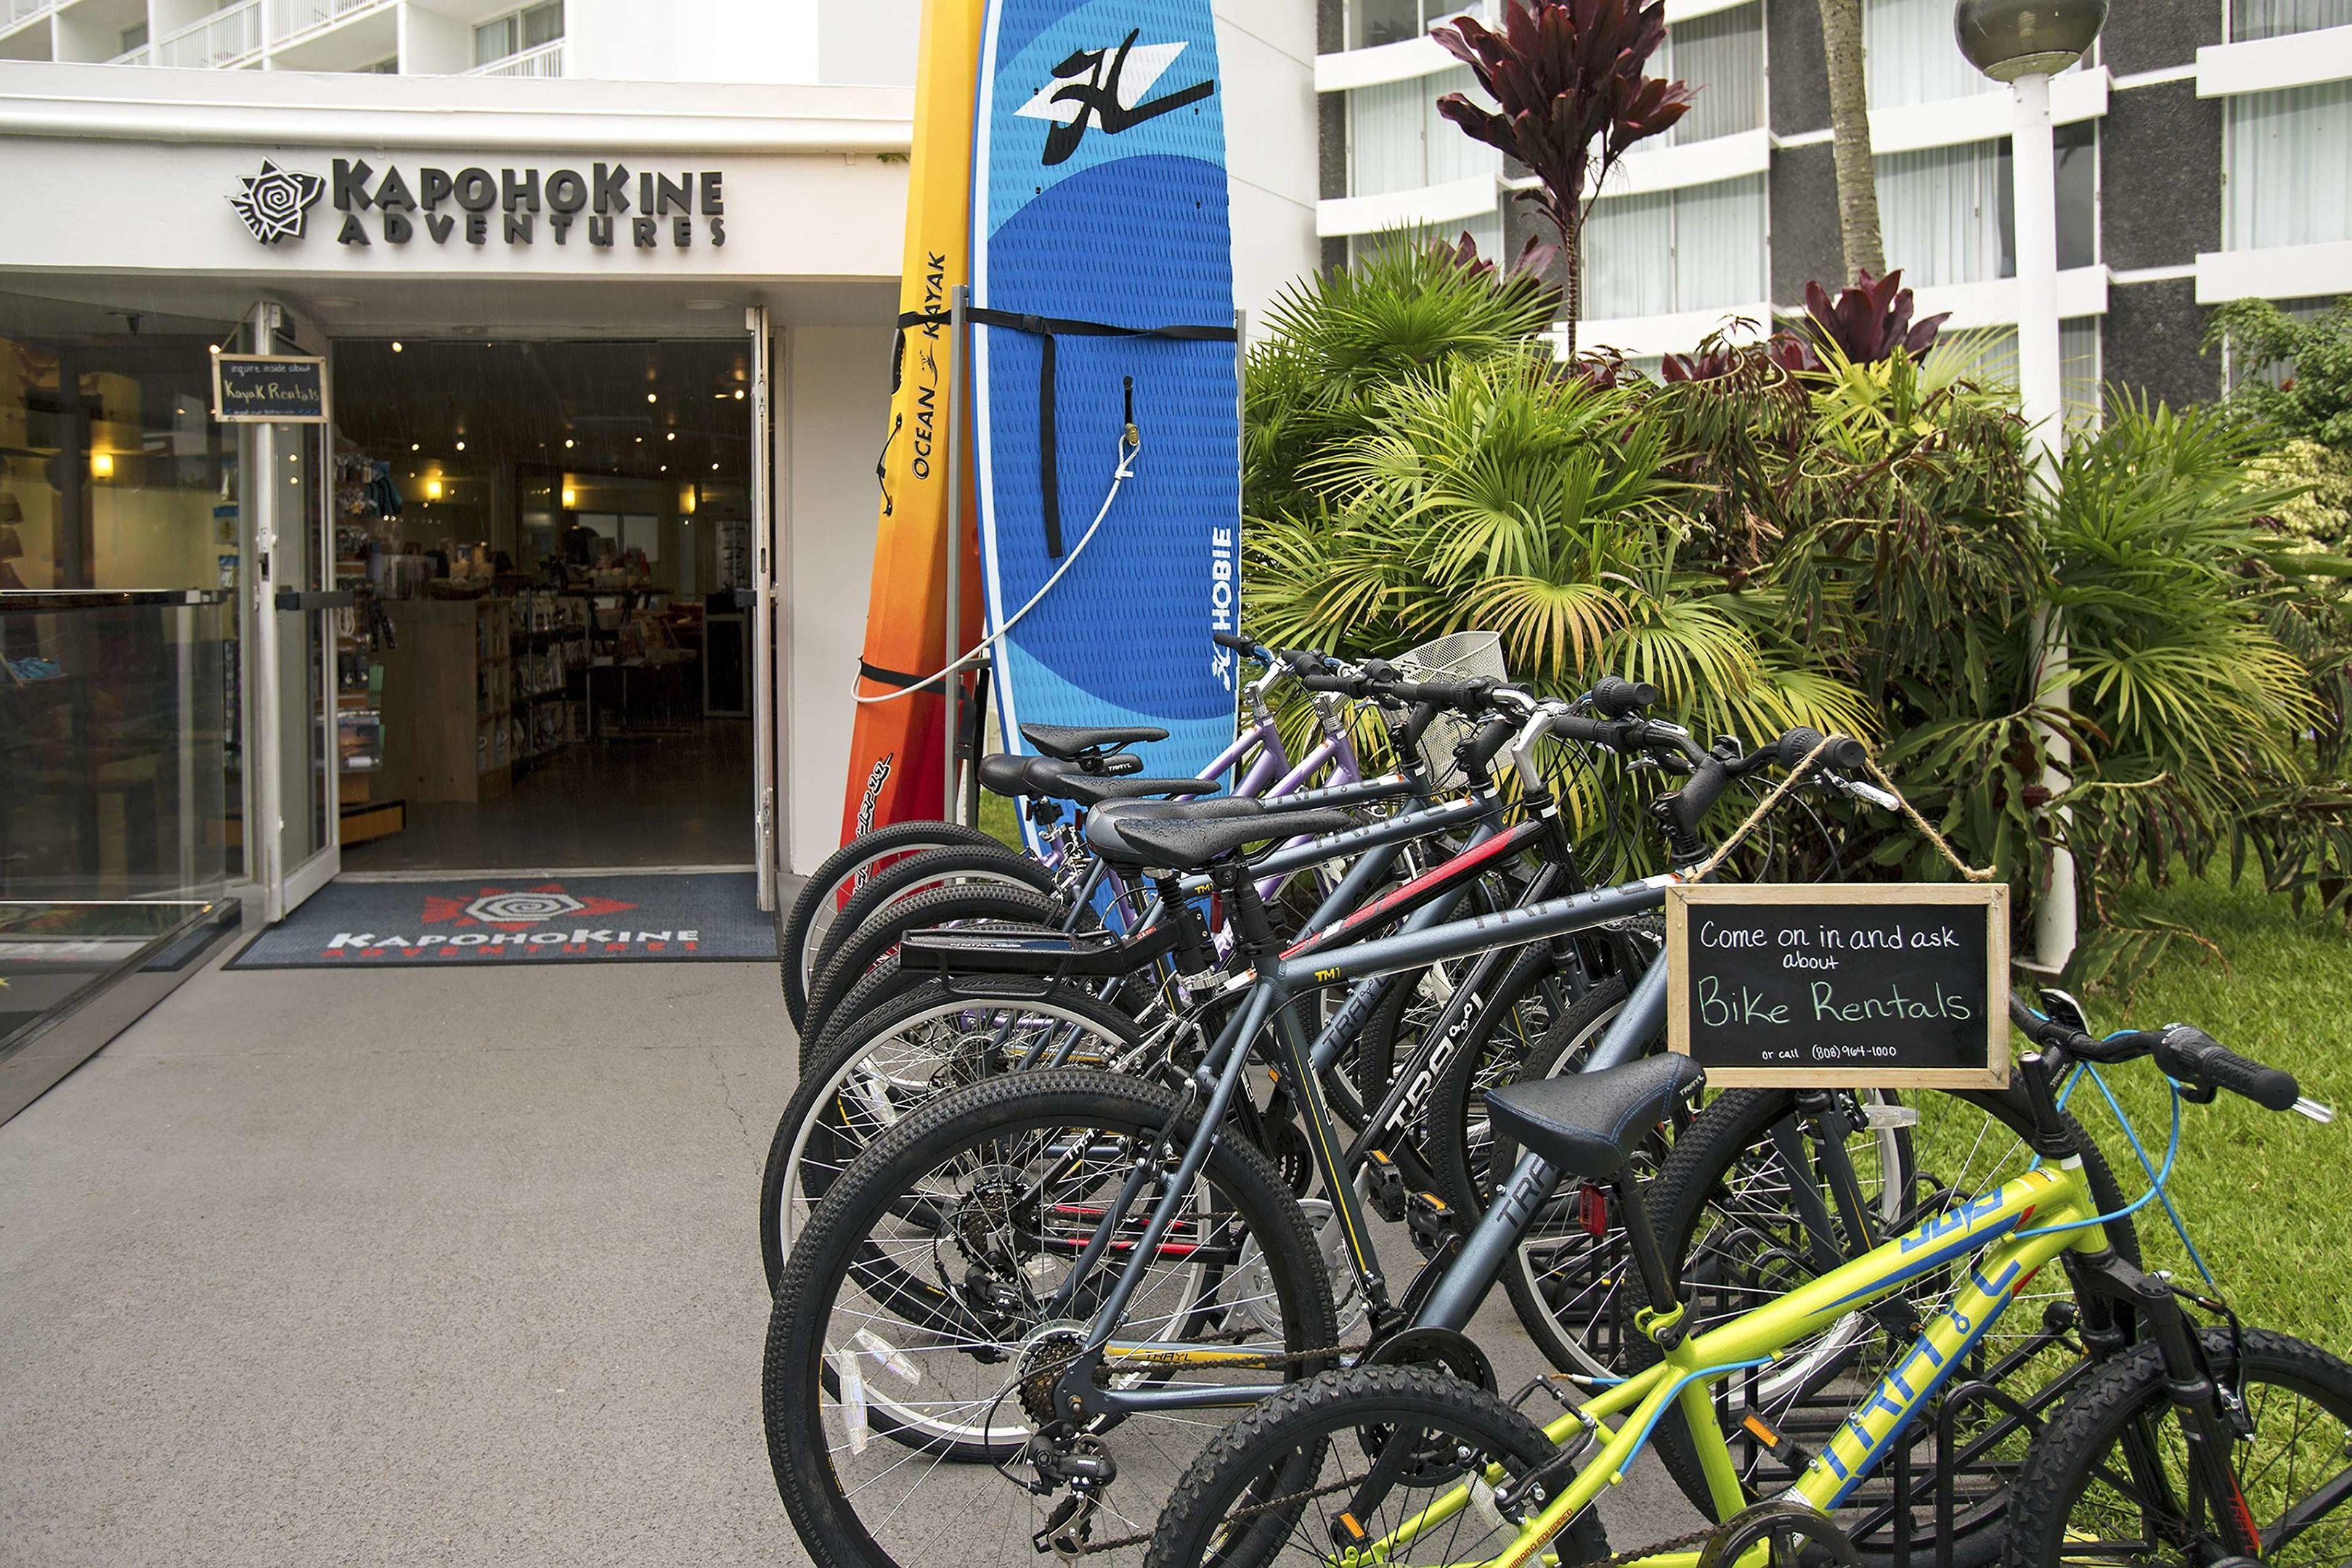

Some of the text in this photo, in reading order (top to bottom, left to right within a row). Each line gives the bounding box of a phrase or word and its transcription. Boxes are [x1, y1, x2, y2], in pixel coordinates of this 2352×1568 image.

[332, 158, 725, 216] KAPOHOKINE
[338, 213, 725, 248] ADVENTURES
[264, 364, 287, 373] inside
[288, 363, 312, 372] about
[912, 250, 945, 481] OCEAN KAYAK
[267, 382, 320, 401] Rentals
[1211, 527, 1232, 630] HOBIE
[327, 929, 699, 949] KAPOHOKINE
[1701, 920, 1960, 950] Come on in and ask
[1783, 952, 1839, 970] about
[1811, 981, 1971, 1022] Rentals
[1762, 1050, 1775, 1061] or
[1778, 1047, 1799, 1059] call
[1537, 1508, 1574, 1545] EQUIPPED
